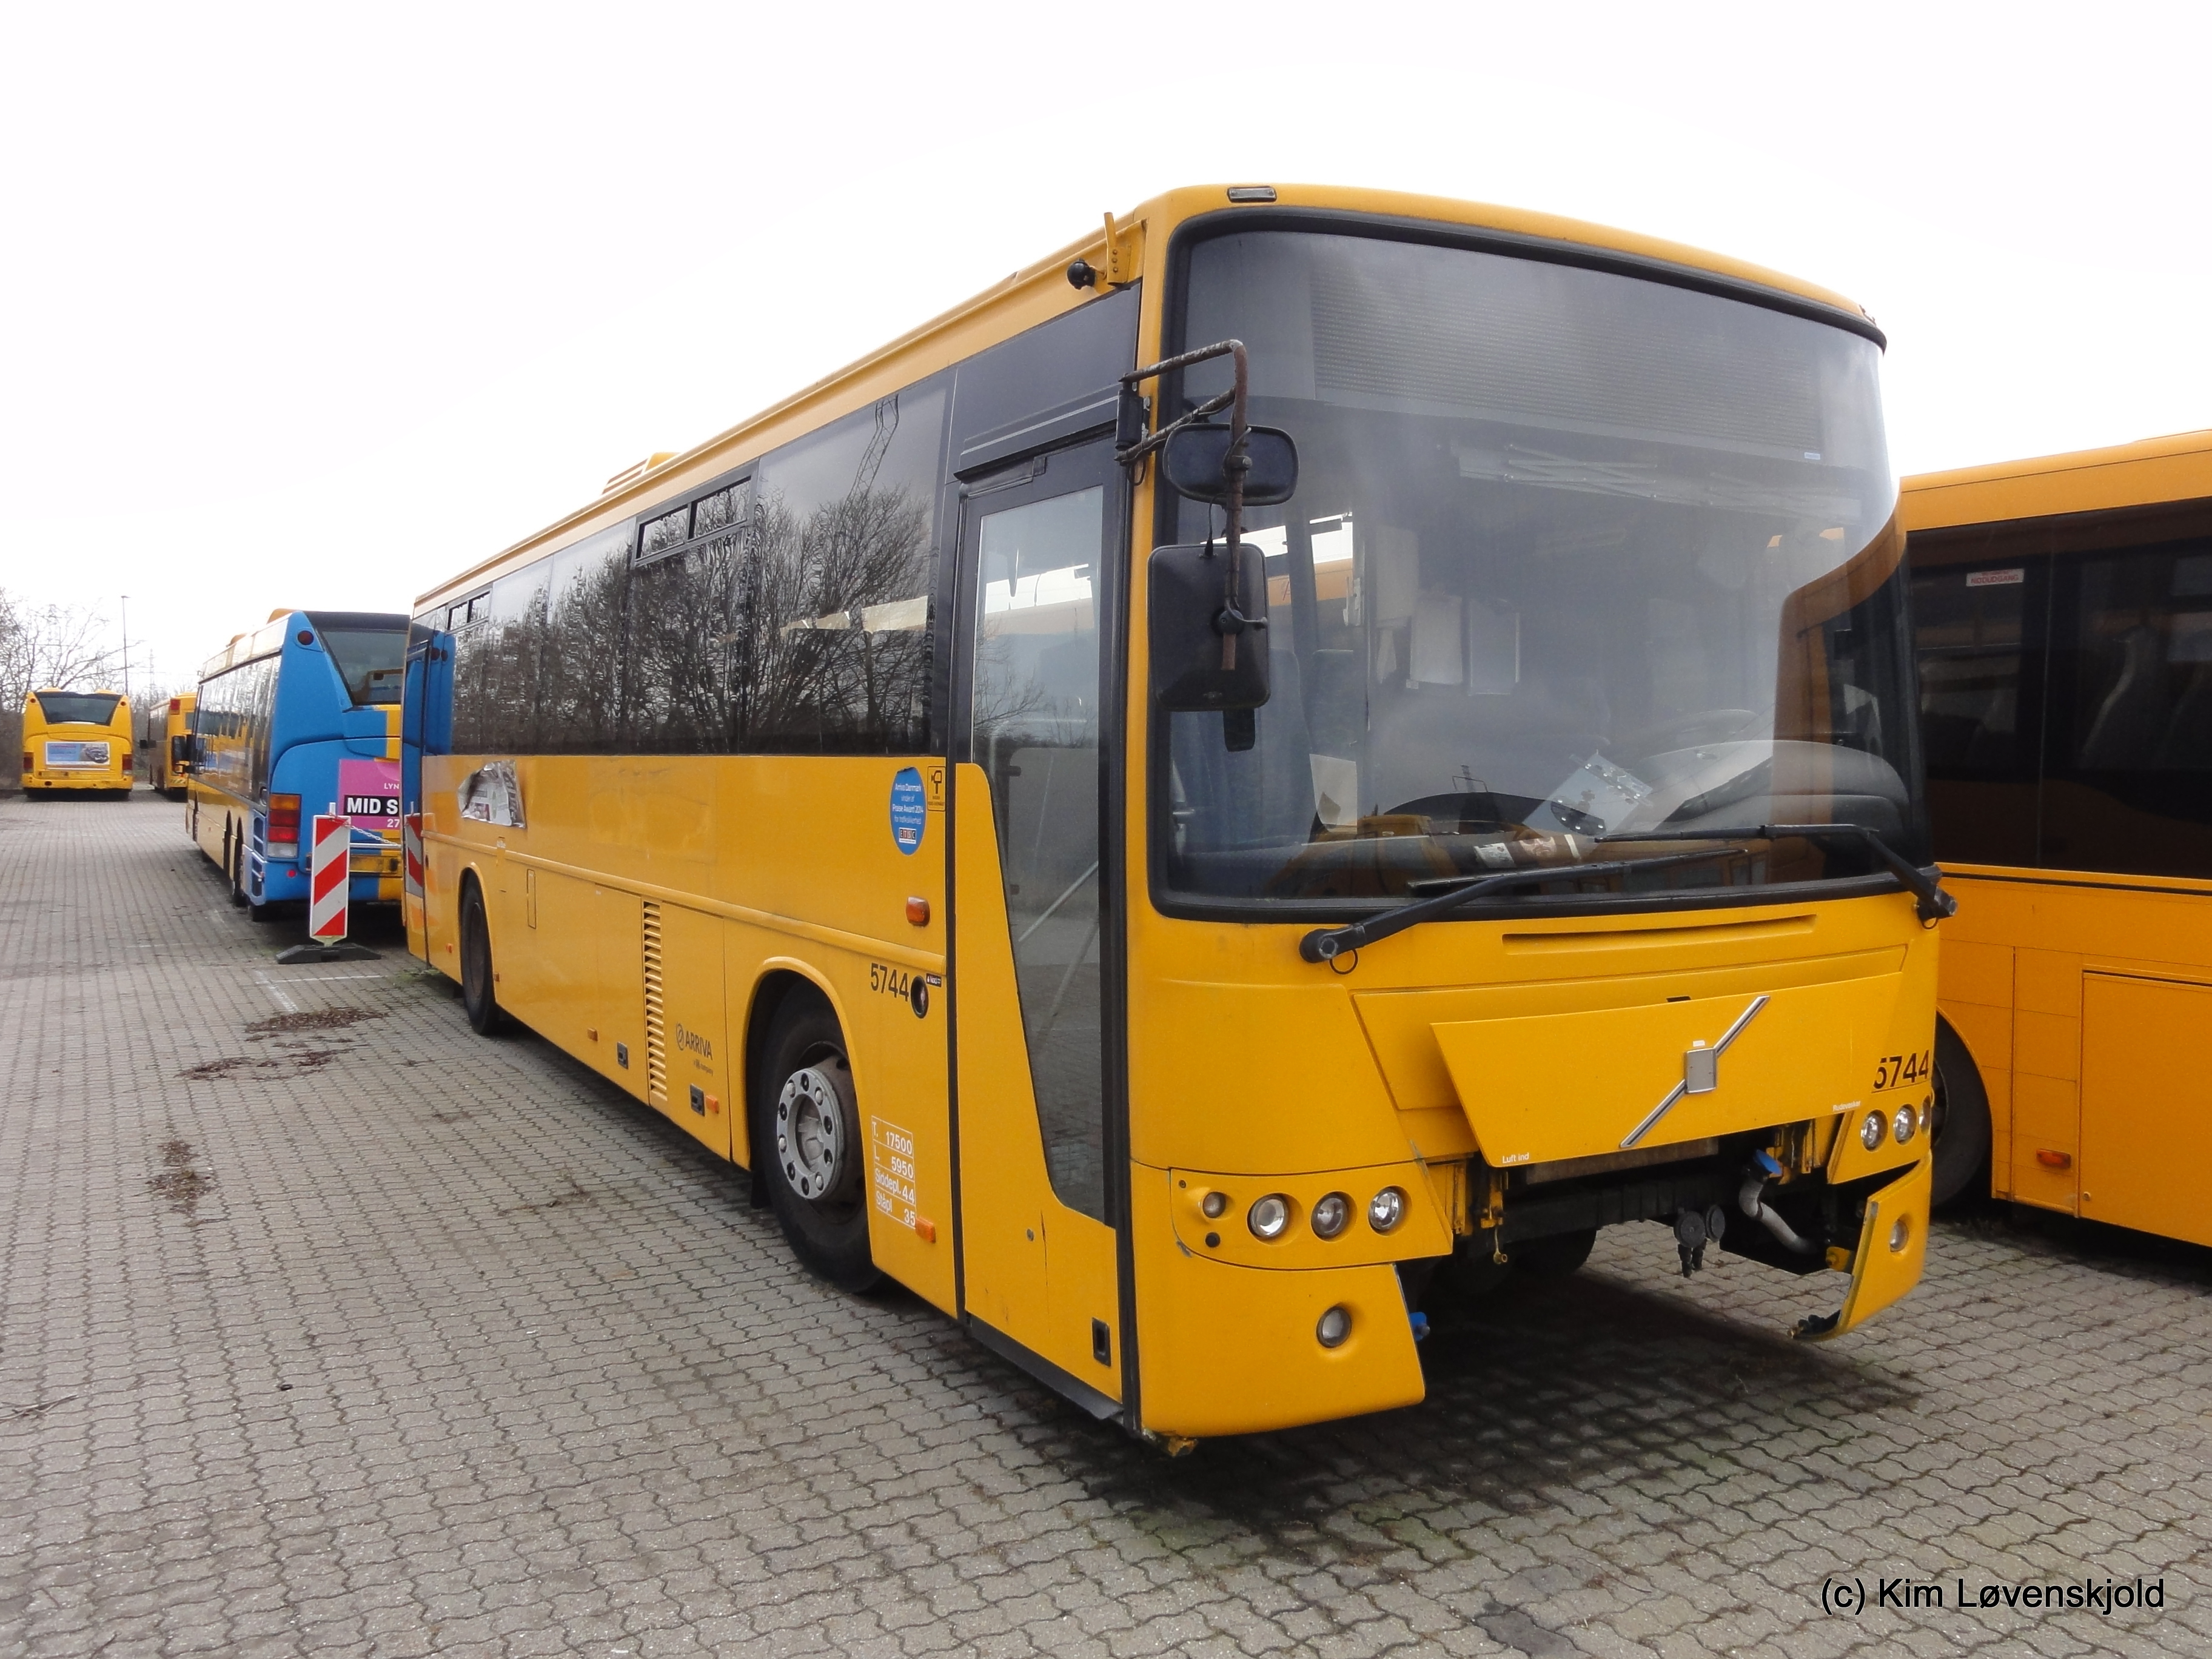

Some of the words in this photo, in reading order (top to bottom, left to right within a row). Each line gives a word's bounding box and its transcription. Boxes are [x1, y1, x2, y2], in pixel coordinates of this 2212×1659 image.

[905, 783, 922, 792] Danmark
[347, 797, 381, 814] MID
[386, 799, 398, 815] S
[387, 819, 400, 828] 27
[871, 962, 909, 1002] 5744
[685, 1030, 713, 1061] ARRIVA
[1873, 1050, 1929, 1089] 5744
[872, 1122, 878, 1137] T.
[886, 1131, 913, 1155] 17500
[891, 1156, 914, 1179] 5950
[1502, 1155, 1516, 1164] Luft
[902, 1185, 915, 1204] 44
[904, 1208, 916, 1226] 35
